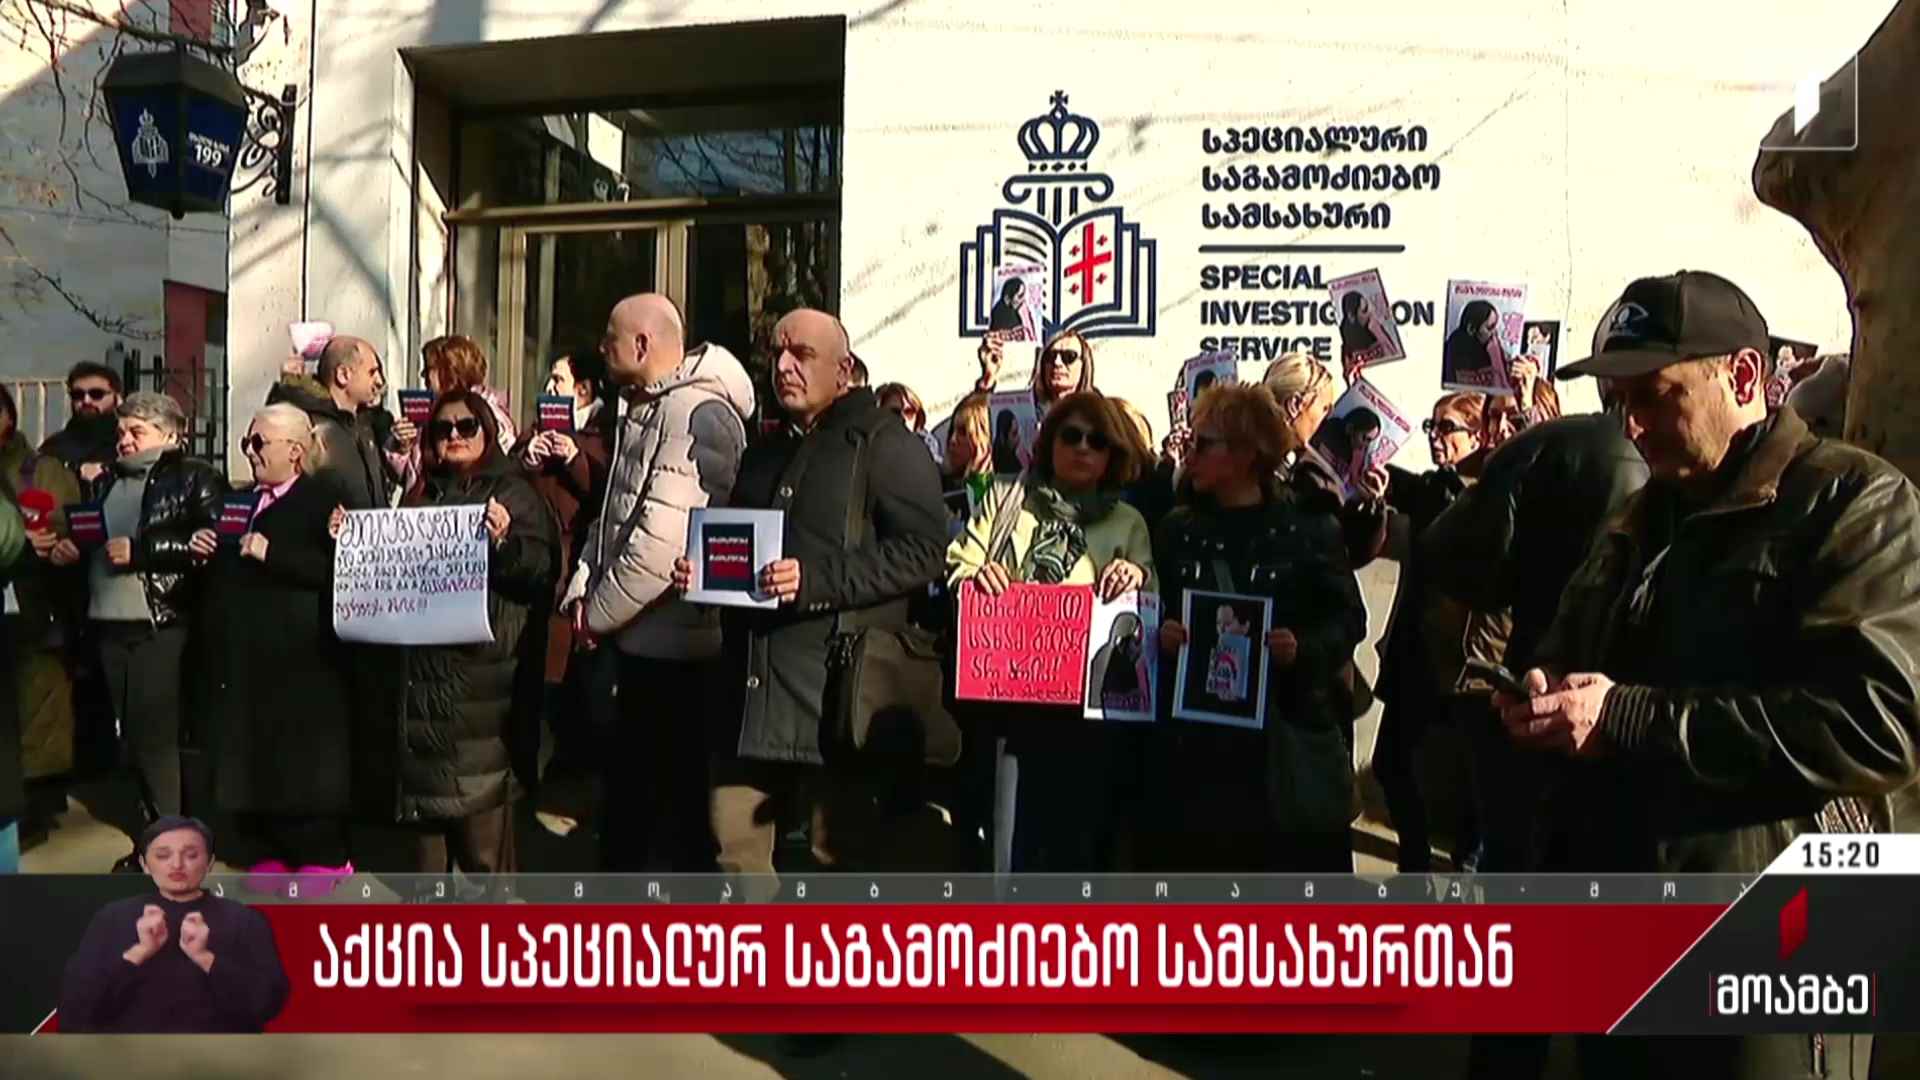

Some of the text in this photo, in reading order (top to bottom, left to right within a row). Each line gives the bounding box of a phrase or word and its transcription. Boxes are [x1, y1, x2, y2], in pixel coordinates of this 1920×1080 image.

[1202, 125, 1428, 154] სპეციალური
[195, 144, 222, 167] 199
[1202, 164, 1441, 192] საგამოძიებო
[1202, 202, 1392, 229] სამსახური
[1200, 264, 1328, 290] SPECIAL
[1200, 300, 1434, 326] INVESTIGON
